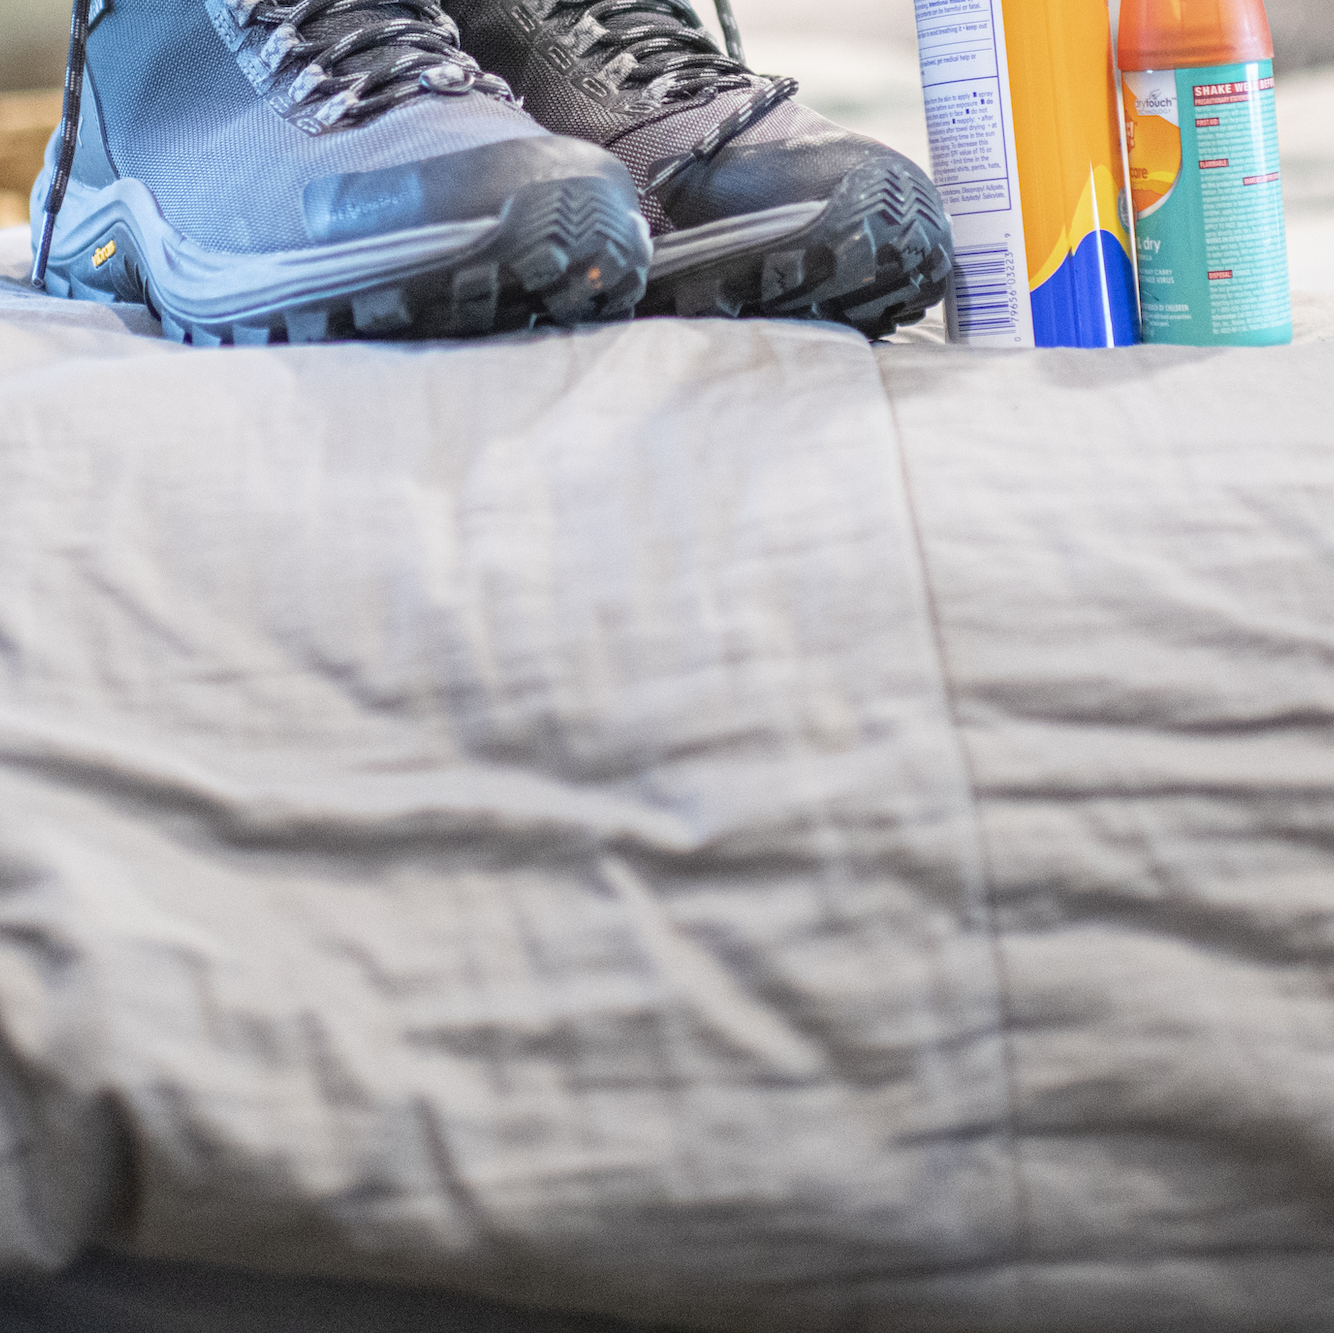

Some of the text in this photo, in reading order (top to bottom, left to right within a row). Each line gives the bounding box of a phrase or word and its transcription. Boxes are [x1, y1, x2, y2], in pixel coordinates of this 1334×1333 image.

[944, 55, 959, 63] medical
[960, 54, 970, 62] help
[1195, 84, 1232, 96] SHAKE
[1234, 81, 1258, 93] WE
[958, 93, 970, 101] apply
[956, 101, 978, 109] exposure
[969, 123, 985, 131] drying
[979, 138, 988, 146] this
[1143, 237, 1161, 254] dry
[1157, 276, 1174, 284] VIRUS
[1165, 304, 1189, 312] CHILDREN
